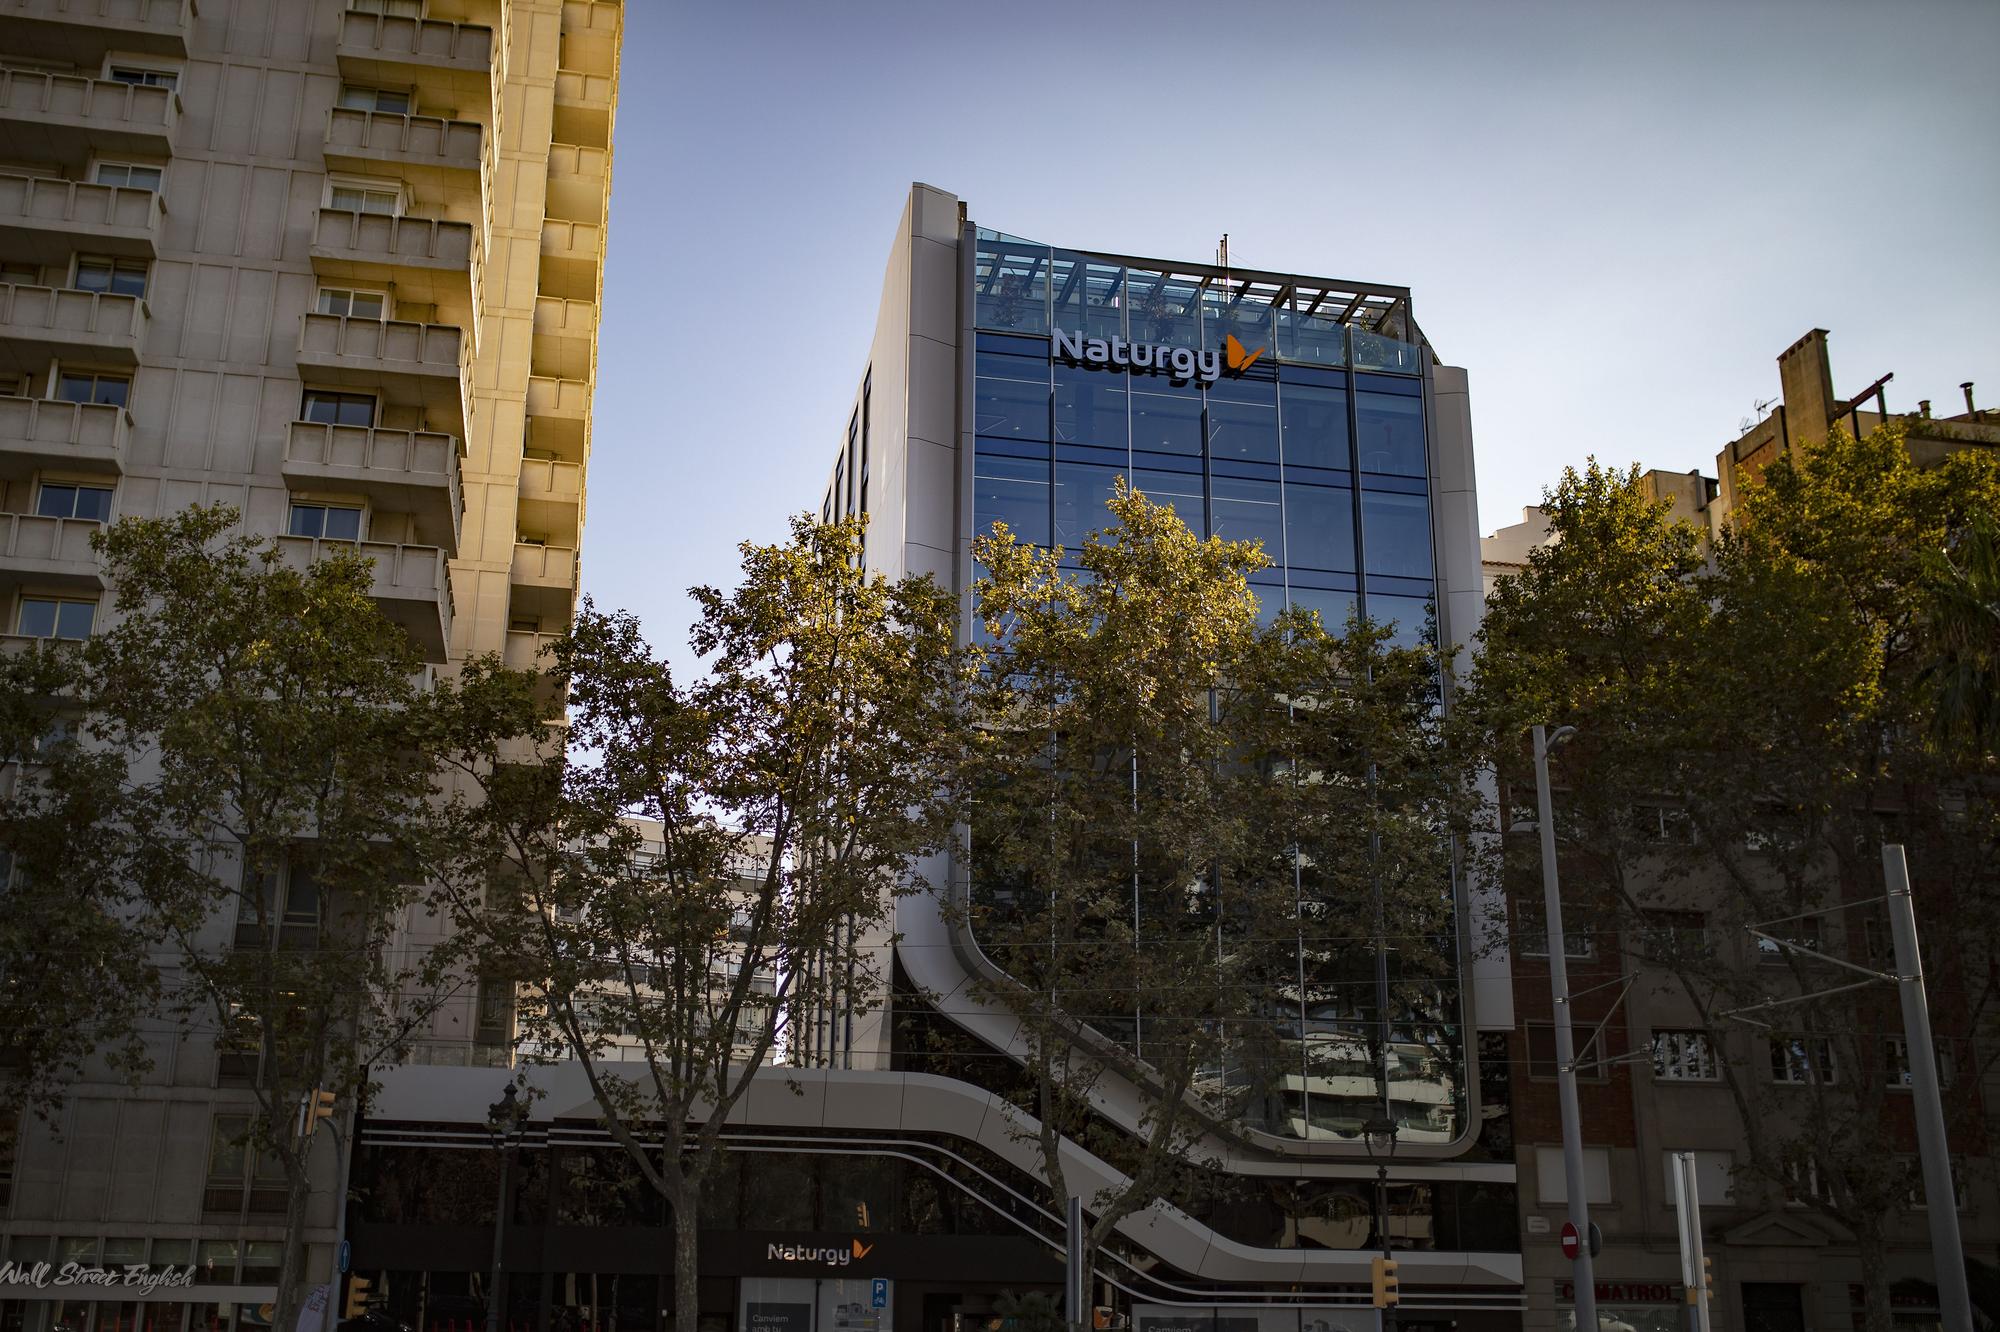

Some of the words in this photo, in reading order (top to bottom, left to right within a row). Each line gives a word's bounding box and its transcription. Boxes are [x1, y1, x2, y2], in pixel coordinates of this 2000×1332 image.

[1053, 327, 1220, 381] Naturgy
[767, 1243, 850, 1266] Naturgy
[0, 1260, 51, 1288] Wall
[53, 1261, 122, 1287] Street
[124, 1264, 197, 1296] English
[876, 1282, 884, 1294] P
[1562, 1284, 1681, 1302] CMATROL
[752, 1314, 789, 1323] Canviem
